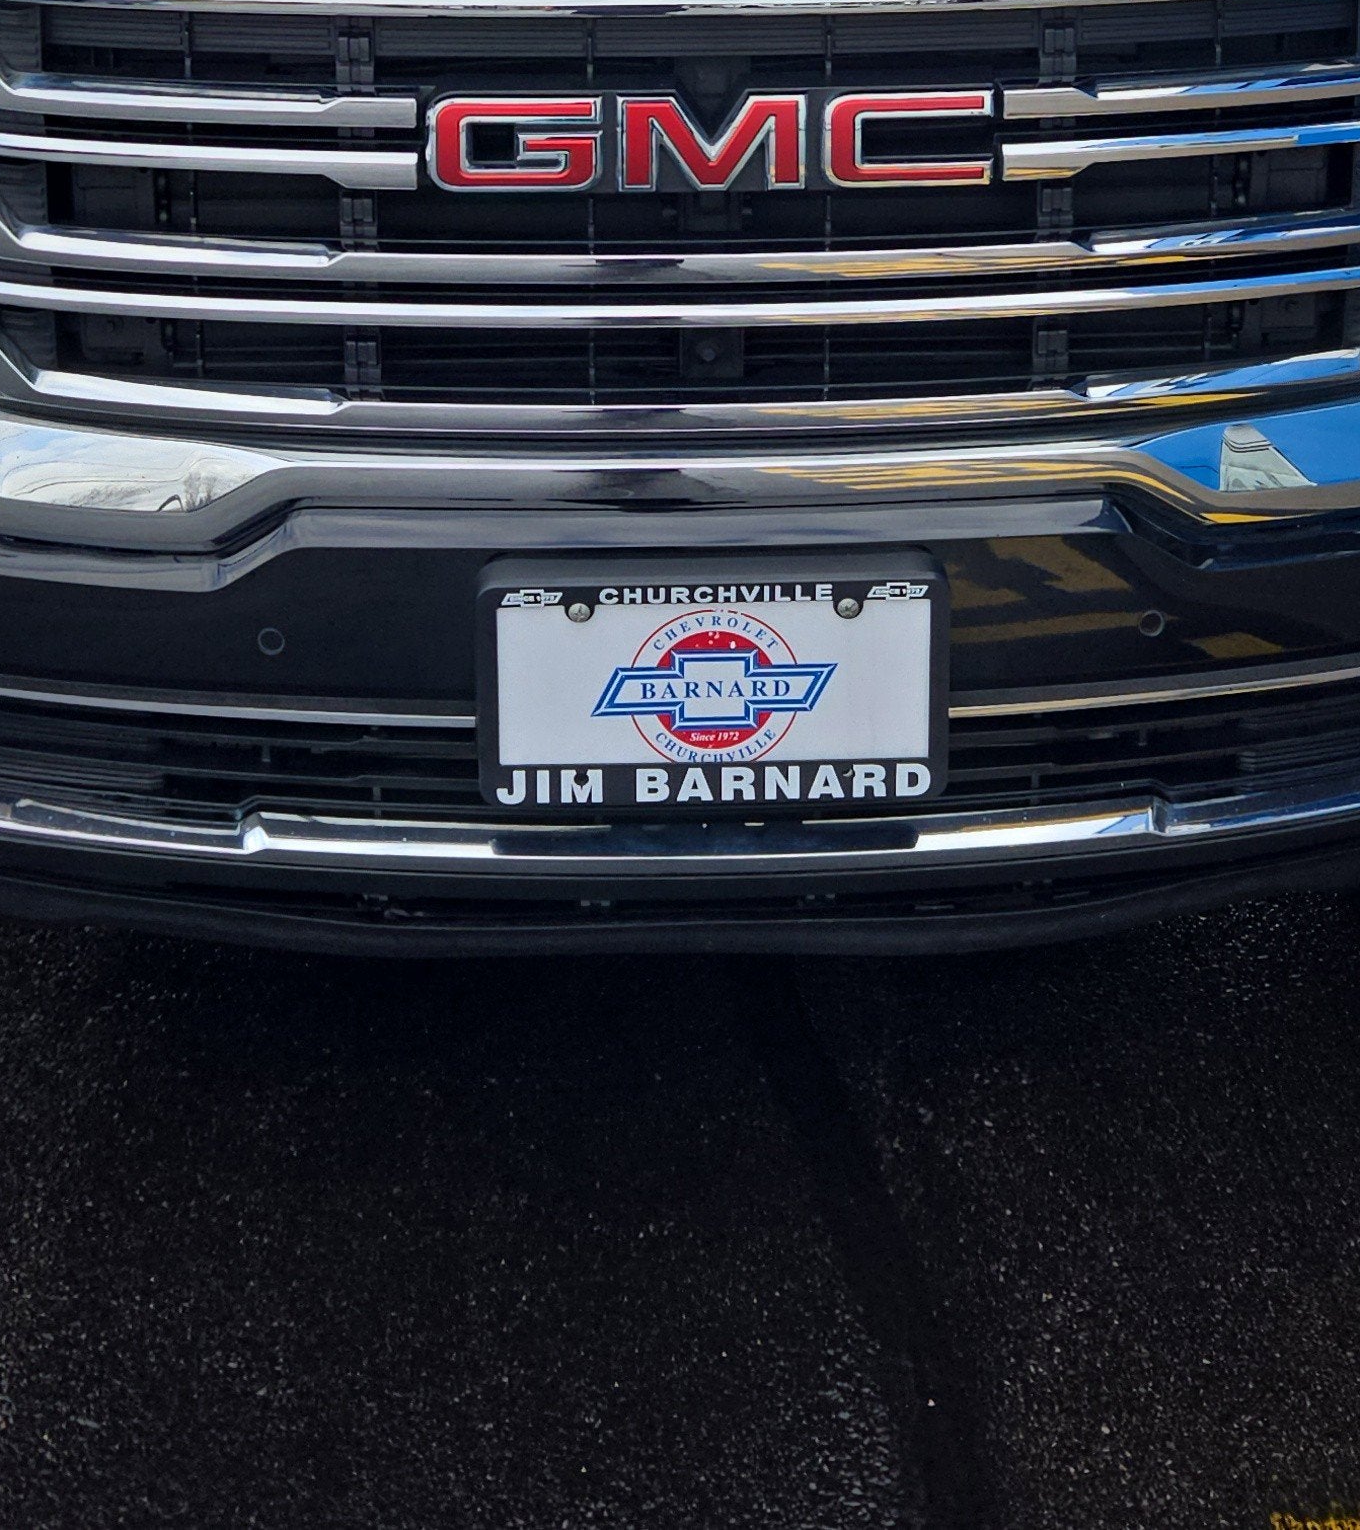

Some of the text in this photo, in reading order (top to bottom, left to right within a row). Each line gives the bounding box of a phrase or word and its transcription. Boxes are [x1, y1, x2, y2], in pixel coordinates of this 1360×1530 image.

[426, 89, 995, 191] GMC
[598, 583, 834, 606] CHURCHVILLE
[652, 615, 779, 652] CHEVROLET
[640, 678, 792, 701] BARNARD
[655, 728, 777, 763] CHURCHVILLE
[689, 731, 740, 742] Since 1972
[496, 763, 932, 806] JIM BARNARD
